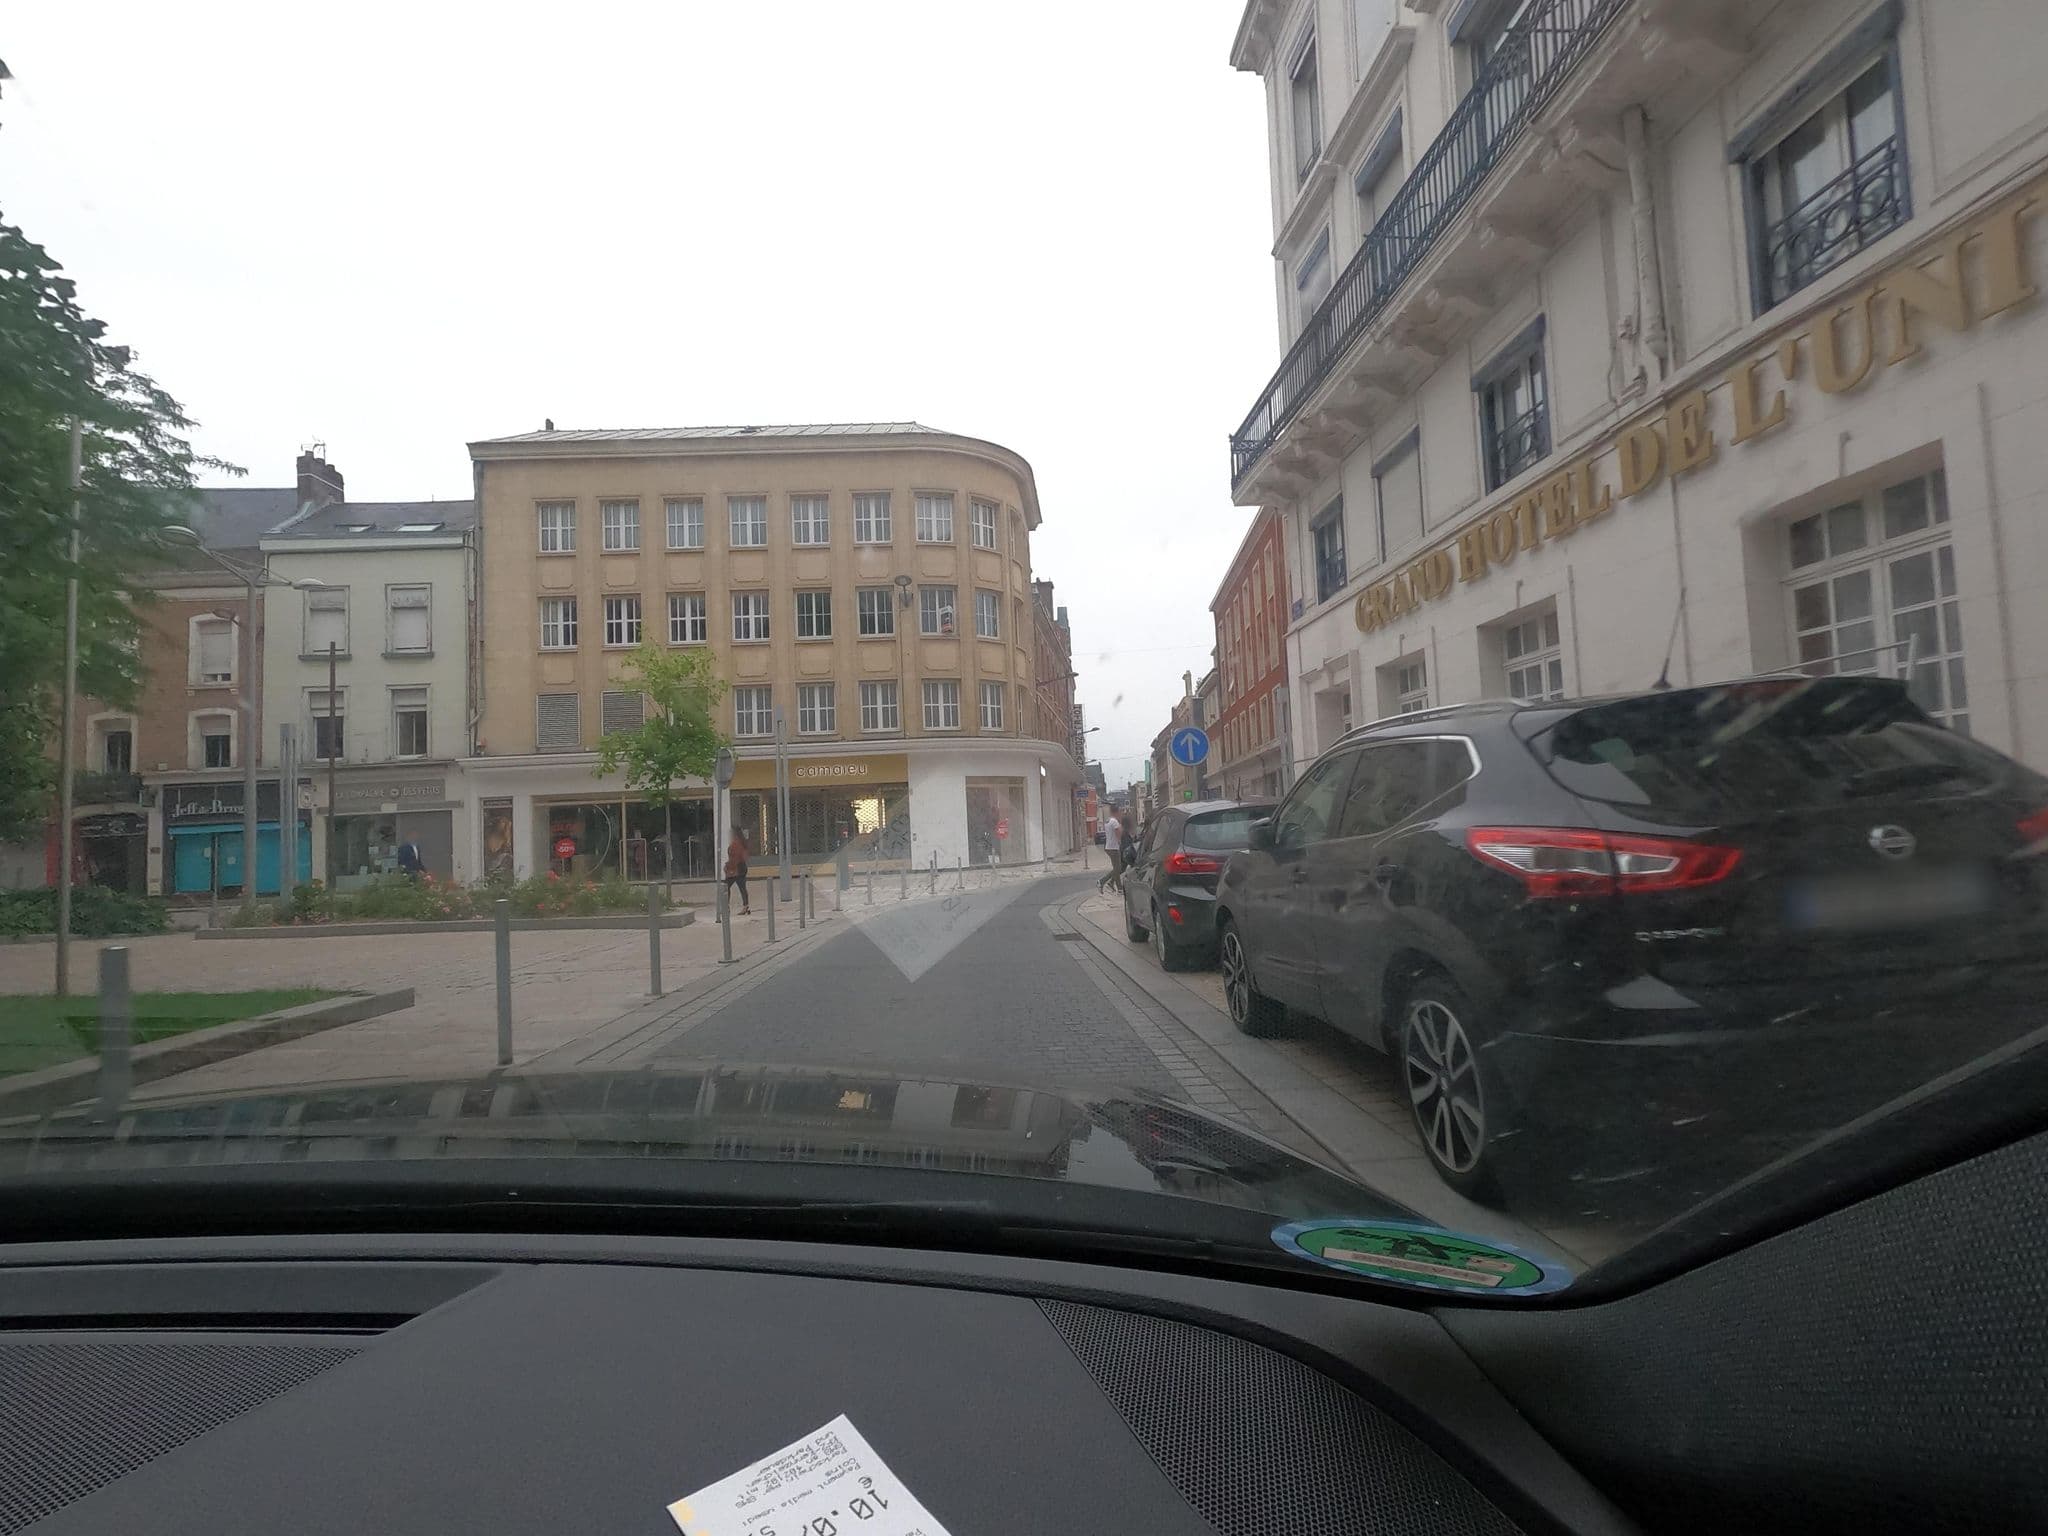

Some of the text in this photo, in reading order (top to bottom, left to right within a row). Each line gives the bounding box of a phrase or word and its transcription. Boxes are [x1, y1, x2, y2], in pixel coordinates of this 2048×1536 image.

[1355, 186, 2048, 633] GRAND HOTEL DE L'UNI
[171, 801, 198, 818] Jeff
[824, 1456, 857, 1476] Coins
